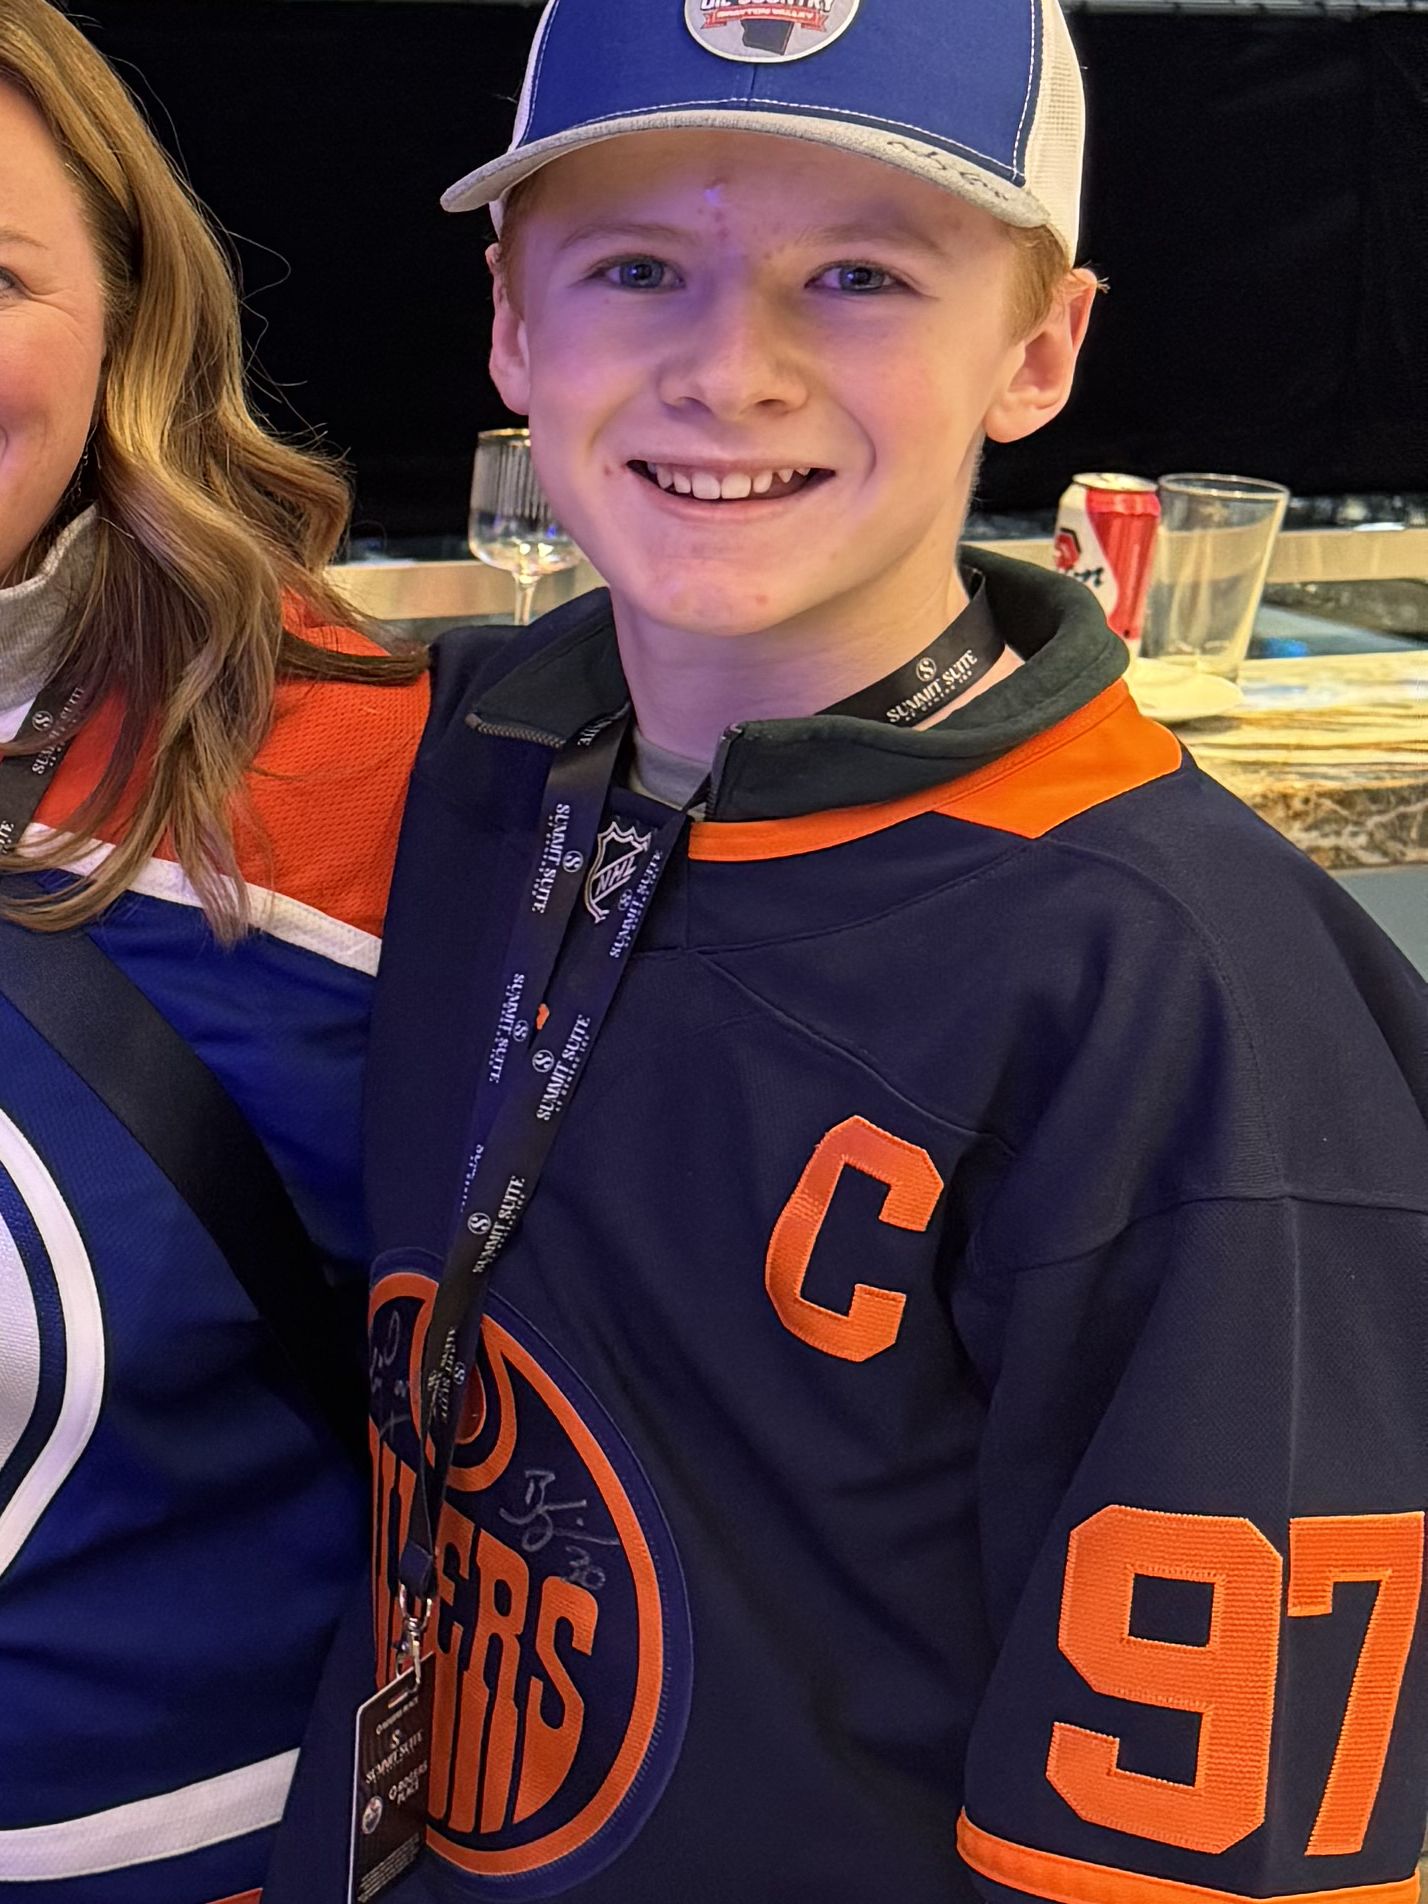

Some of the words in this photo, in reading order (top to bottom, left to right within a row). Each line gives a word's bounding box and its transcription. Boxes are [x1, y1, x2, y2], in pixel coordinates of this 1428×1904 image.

[886, 678, 943, 723] SUMMIT
[942, 649, 978, 686] SUITE
[548, 803, 571, 867] SUMMIT
[536, 867, 557, 914] SUITE
[596, 855, 637, 897] NHL
[501, 973, 525, 1036] SUMMIT
[490, 1036, 509, 1084] SUITE
[536, 1060, 570, 1121] SUMMIT
[561, 1014, 591, 1060] SUITE
[472, 1221, 502, 1274] SUMMIT
[498, 1175, 526, 1220] SUITE
[764, 1114, 944, 1363] C
[1044, 1503, 1426, 1857] 97
